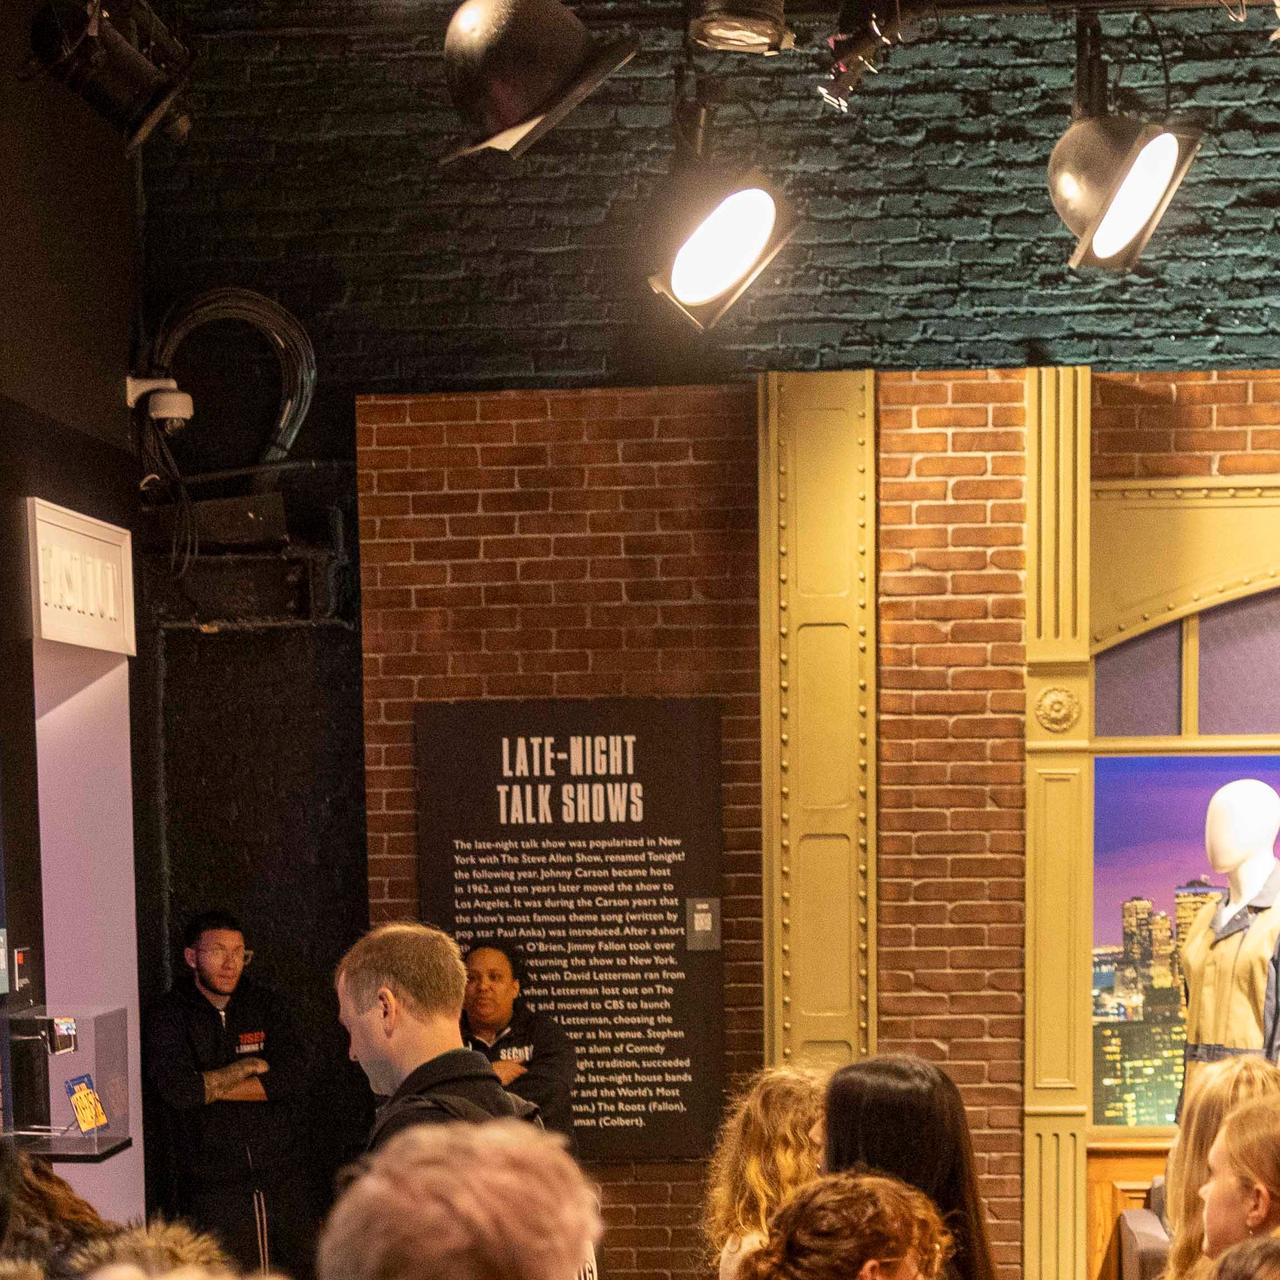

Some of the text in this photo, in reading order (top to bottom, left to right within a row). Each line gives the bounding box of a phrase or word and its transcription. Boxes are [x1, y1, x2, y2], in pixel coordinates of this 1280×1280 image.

[502, 735, 637, 778] LATE-NIGHT
[497, 783, 644, 825] TALK SHOWS
[453, 837, 681, 851] The late-night talk show was popularized in New
[454, 852, 685, 865] York with The Steve Allen Show, renamed Tonight!
[454, 870, 470, 879] the
[472, 870, 515, 880] following
[540, 869, 572, 879] Johnny
[575, 868, 609, 878] Carson
[611, 868, 647, 877] became
[650, 867, 671, 877] host
[454, 885, 464, 893] in
[493, 885, 510, 893] and
[513, 885, 528, 893] ten
[531, 885, 556, 894] years
[558, 883, 581, 892] later
[583, 883, 615, 892] moved
[617, 883, 633, 892] the
[635, 883, 661, 891] show
[455, 900, 472, 909] Los
[514, 899, 522, 908] It
[545, 899, 575, 910] during
[577, 898, 592, 907] the
[595, 897, 629, 907] Carson
[632, 899, 657, 908] years
[659, 897, 679, 906] that
[455, 912, 678, 924] the show's most famous theme song (written by
[456, 930, 474, 940] pop
[477, 929, 495, 938] star
[497, 928, 516, 937] Paul
[518, 928, 546, 939] Anka)
[624, 927, 649, 936] After
[659, 926, 685, 936] short
[566, 943, 595, 954] Jimmy
[598, 943, 627, 952] Fallon
[629, 942, 651, 951] took
[571, 958, 586, 966] the
[589, 957, 614, 966] show
[617, 958, 627, 966] to
[630, 956, 651, 965] New
[653, 956, 678, 965] York.
[541, 972, 561, 981] with
[564, 972, 591, 980] David
[593, 971, 641, 980] Letterman
[662, 971, 685, 979] from
[524, 987, 548, 996] when
[551, 987, 599, 995] Letterman
[601, 986, 619, 995] lost
[656, 985, 673, 994] The
[538, 1002, 555, 1010] and
[557, 1001, 589, 1010] moved
[591, 1002, 601, 1010] to
[604, 1001, 625, 1010] CBS
[640, 1000, 671, 1009] launch
[561, 1015, 611, 1025] Letterman,
[614, 1015, 655, 1026] choosing
[657, 1015, 673, 1023] the
[599, 1030, 612, 1039] his
[647, 1029, 685, 1040] Stephen
[589, 1045, 611, 1053] alum
[614, 1044, 624, 1053] of
[626, 1044, 666, 1055] Comedy
[597, 1059, 640, 1068] tradition,
[641, 1058, 690, 1068] succeeded
[589, 1074, 632, 1084] late-night
[635, 1074, 663, 1082] house
[665, 1073, 692, 1082] bands
[581, 1088, 597, 1097] and
[600, 1089, 615, 1097] the
[617, 1088, 653, 1097] World's
[656, 1088, 679, 1096] Most
[597, 1102, 615, 1111] The
[618, 1102, 646, 1111] Roots
[599, 1117, 646, 1128] (Colbert).
